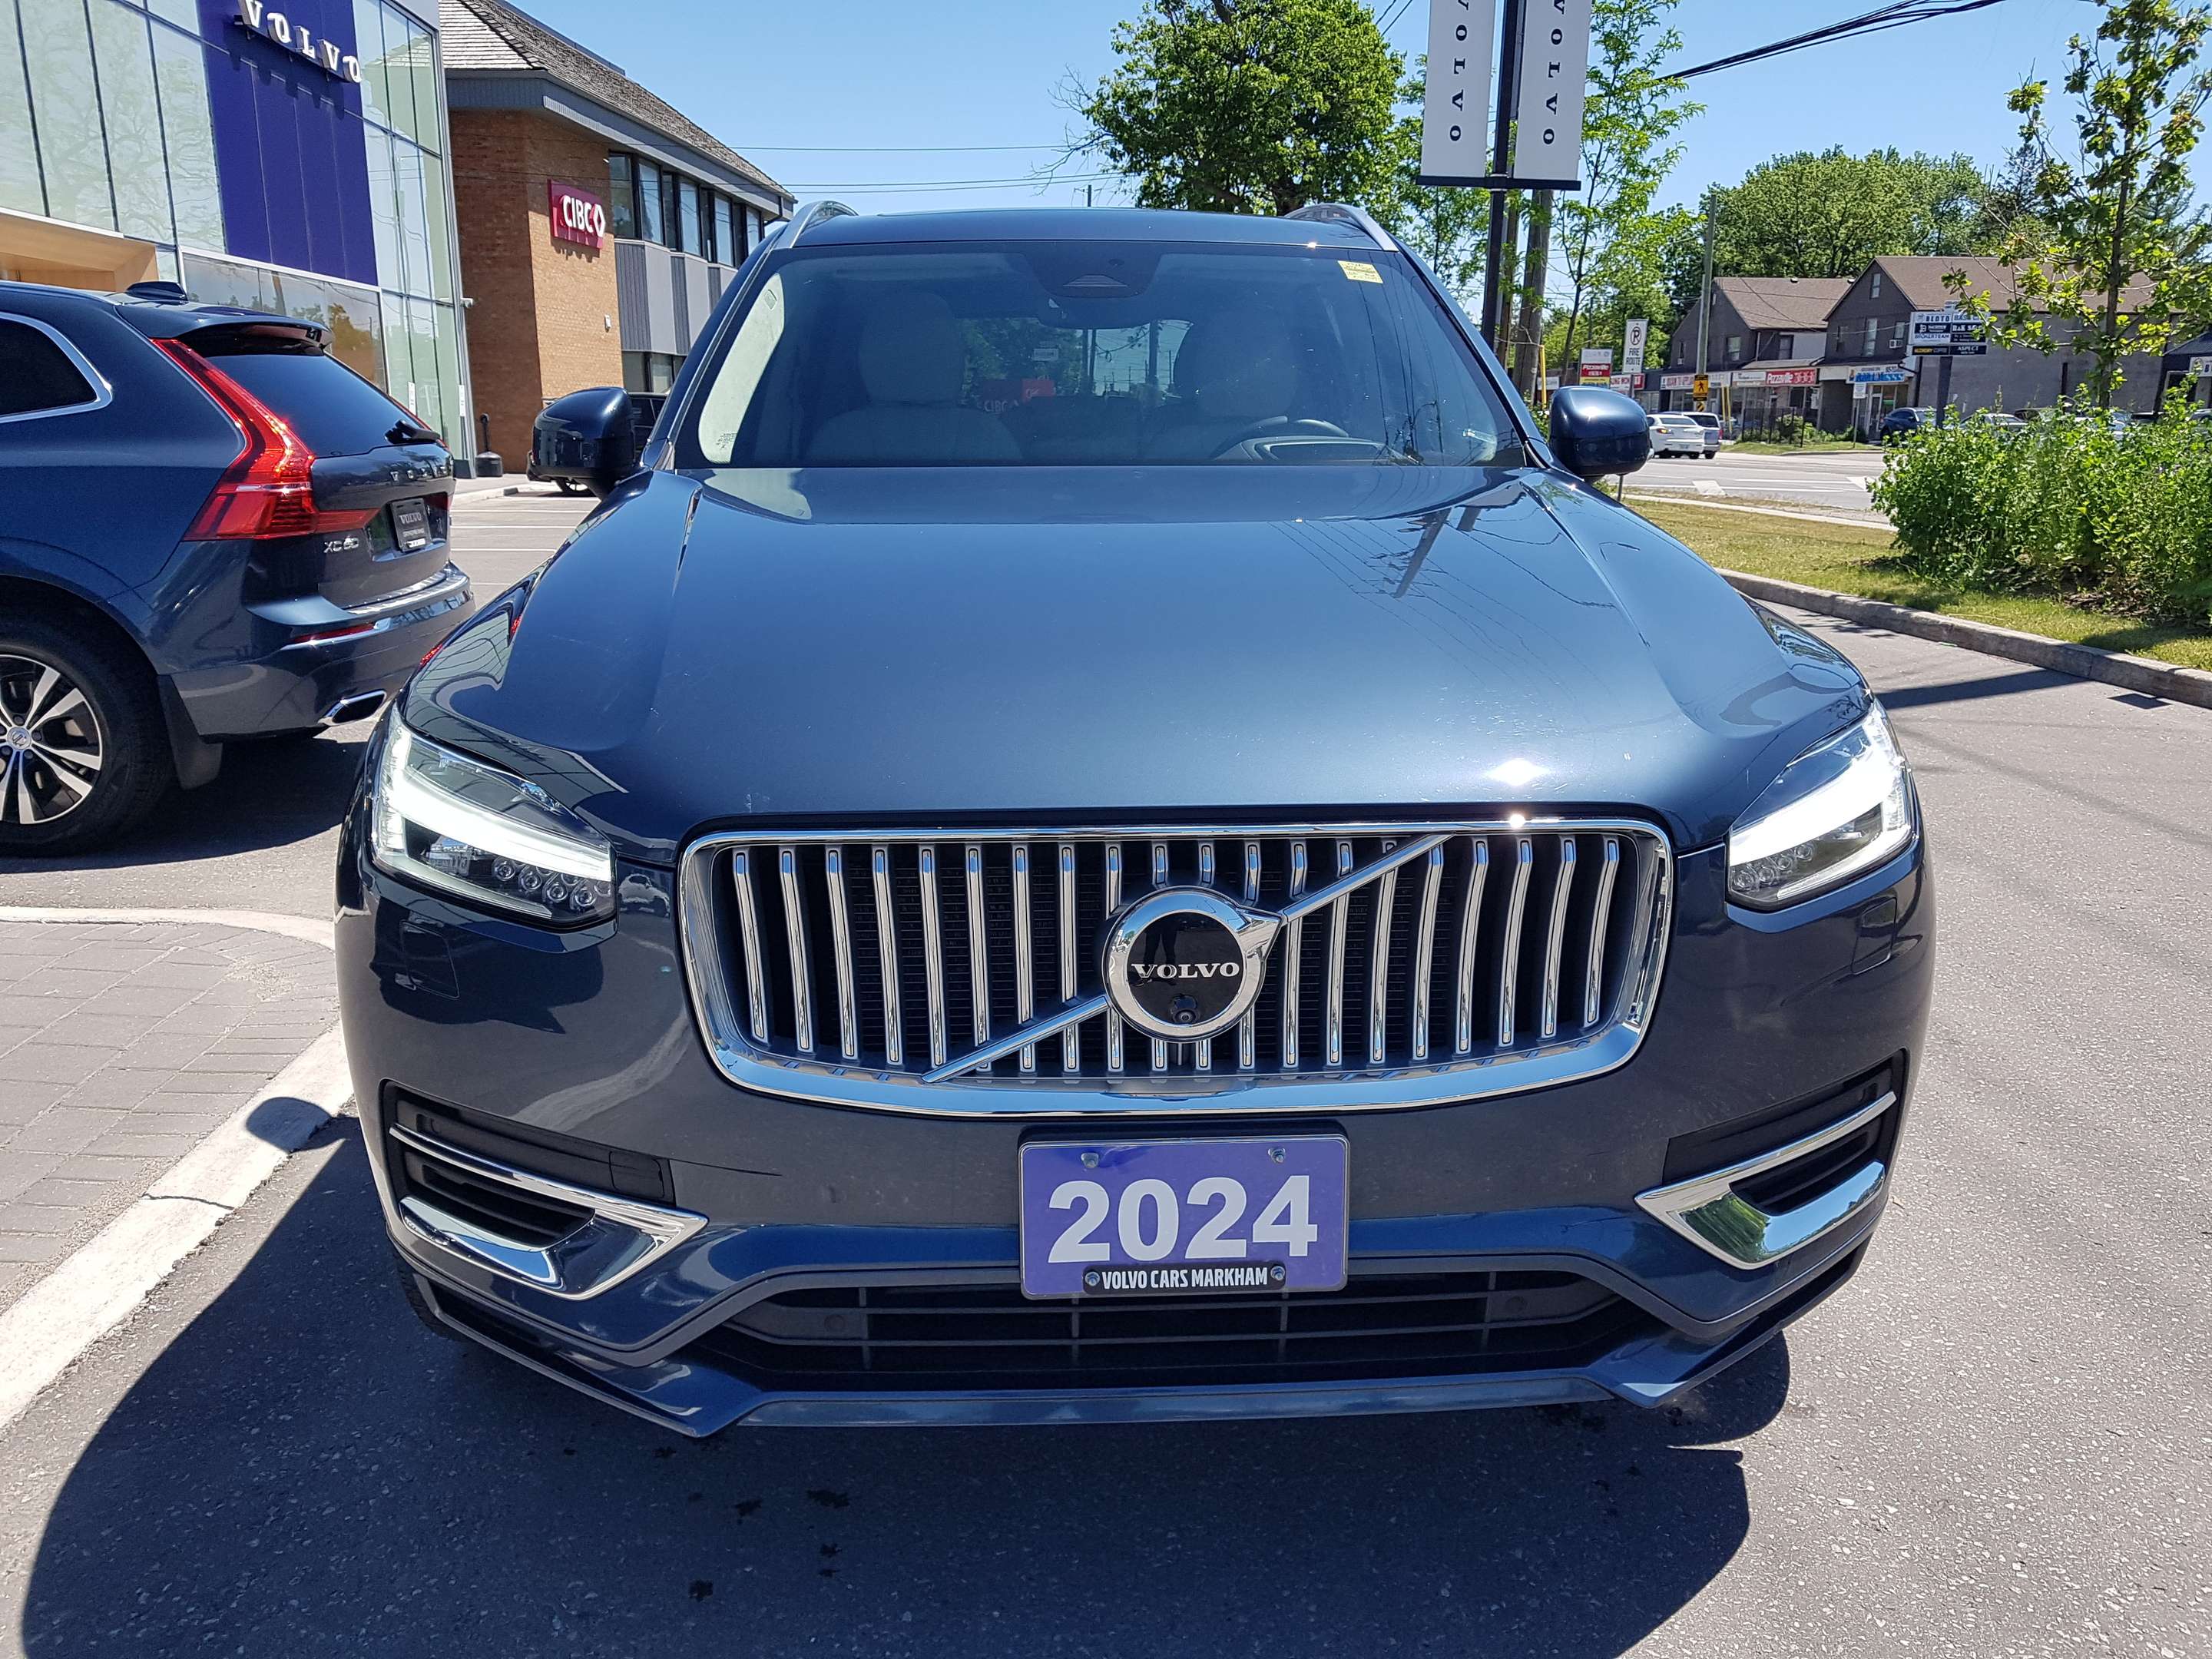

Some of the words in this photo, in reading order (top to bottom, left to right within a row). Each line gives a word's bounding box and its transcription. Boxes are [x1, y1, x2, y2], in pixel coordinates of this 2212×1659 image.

[243, 0, 363, 84] VOLVO
[561, 194, 594, 233] CIBC
[1626, 357, 1641, 366] ROUTE
[1628, 348, 1640, 356] FIRE
[399, 513, 422, 525] VOLVO
[1131, 962, 1240, 979] VOLVO
[1048, 1174, 1318, 1263] 2024
[1101, 1270, 1147, 1290] VOLVO
[1151, 1269, 1188, 1288] CARS
[1191, 1267, 1267, 1287] MARKHAM
